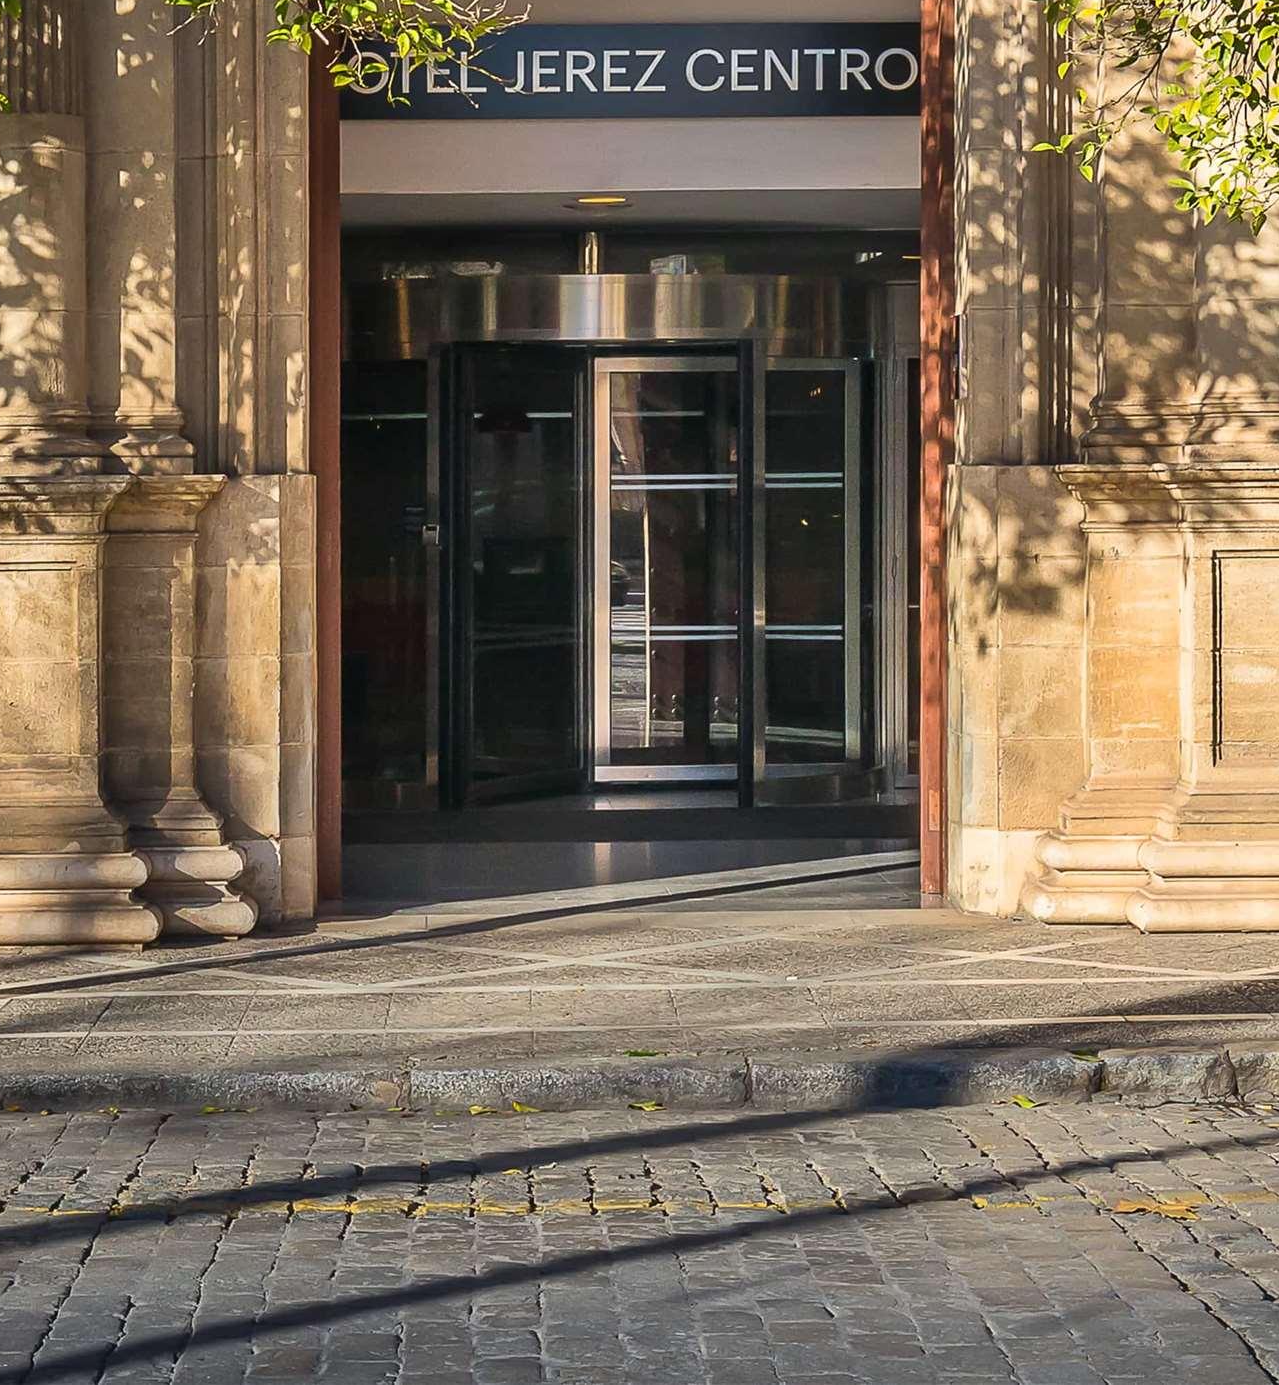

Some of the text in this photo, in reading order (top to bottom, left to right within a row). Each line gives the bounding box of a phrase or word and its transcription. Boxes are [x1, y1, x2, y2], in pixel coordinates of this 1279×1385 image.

[347, 47, 919, 95] OTEL JEREZ CENTRO
